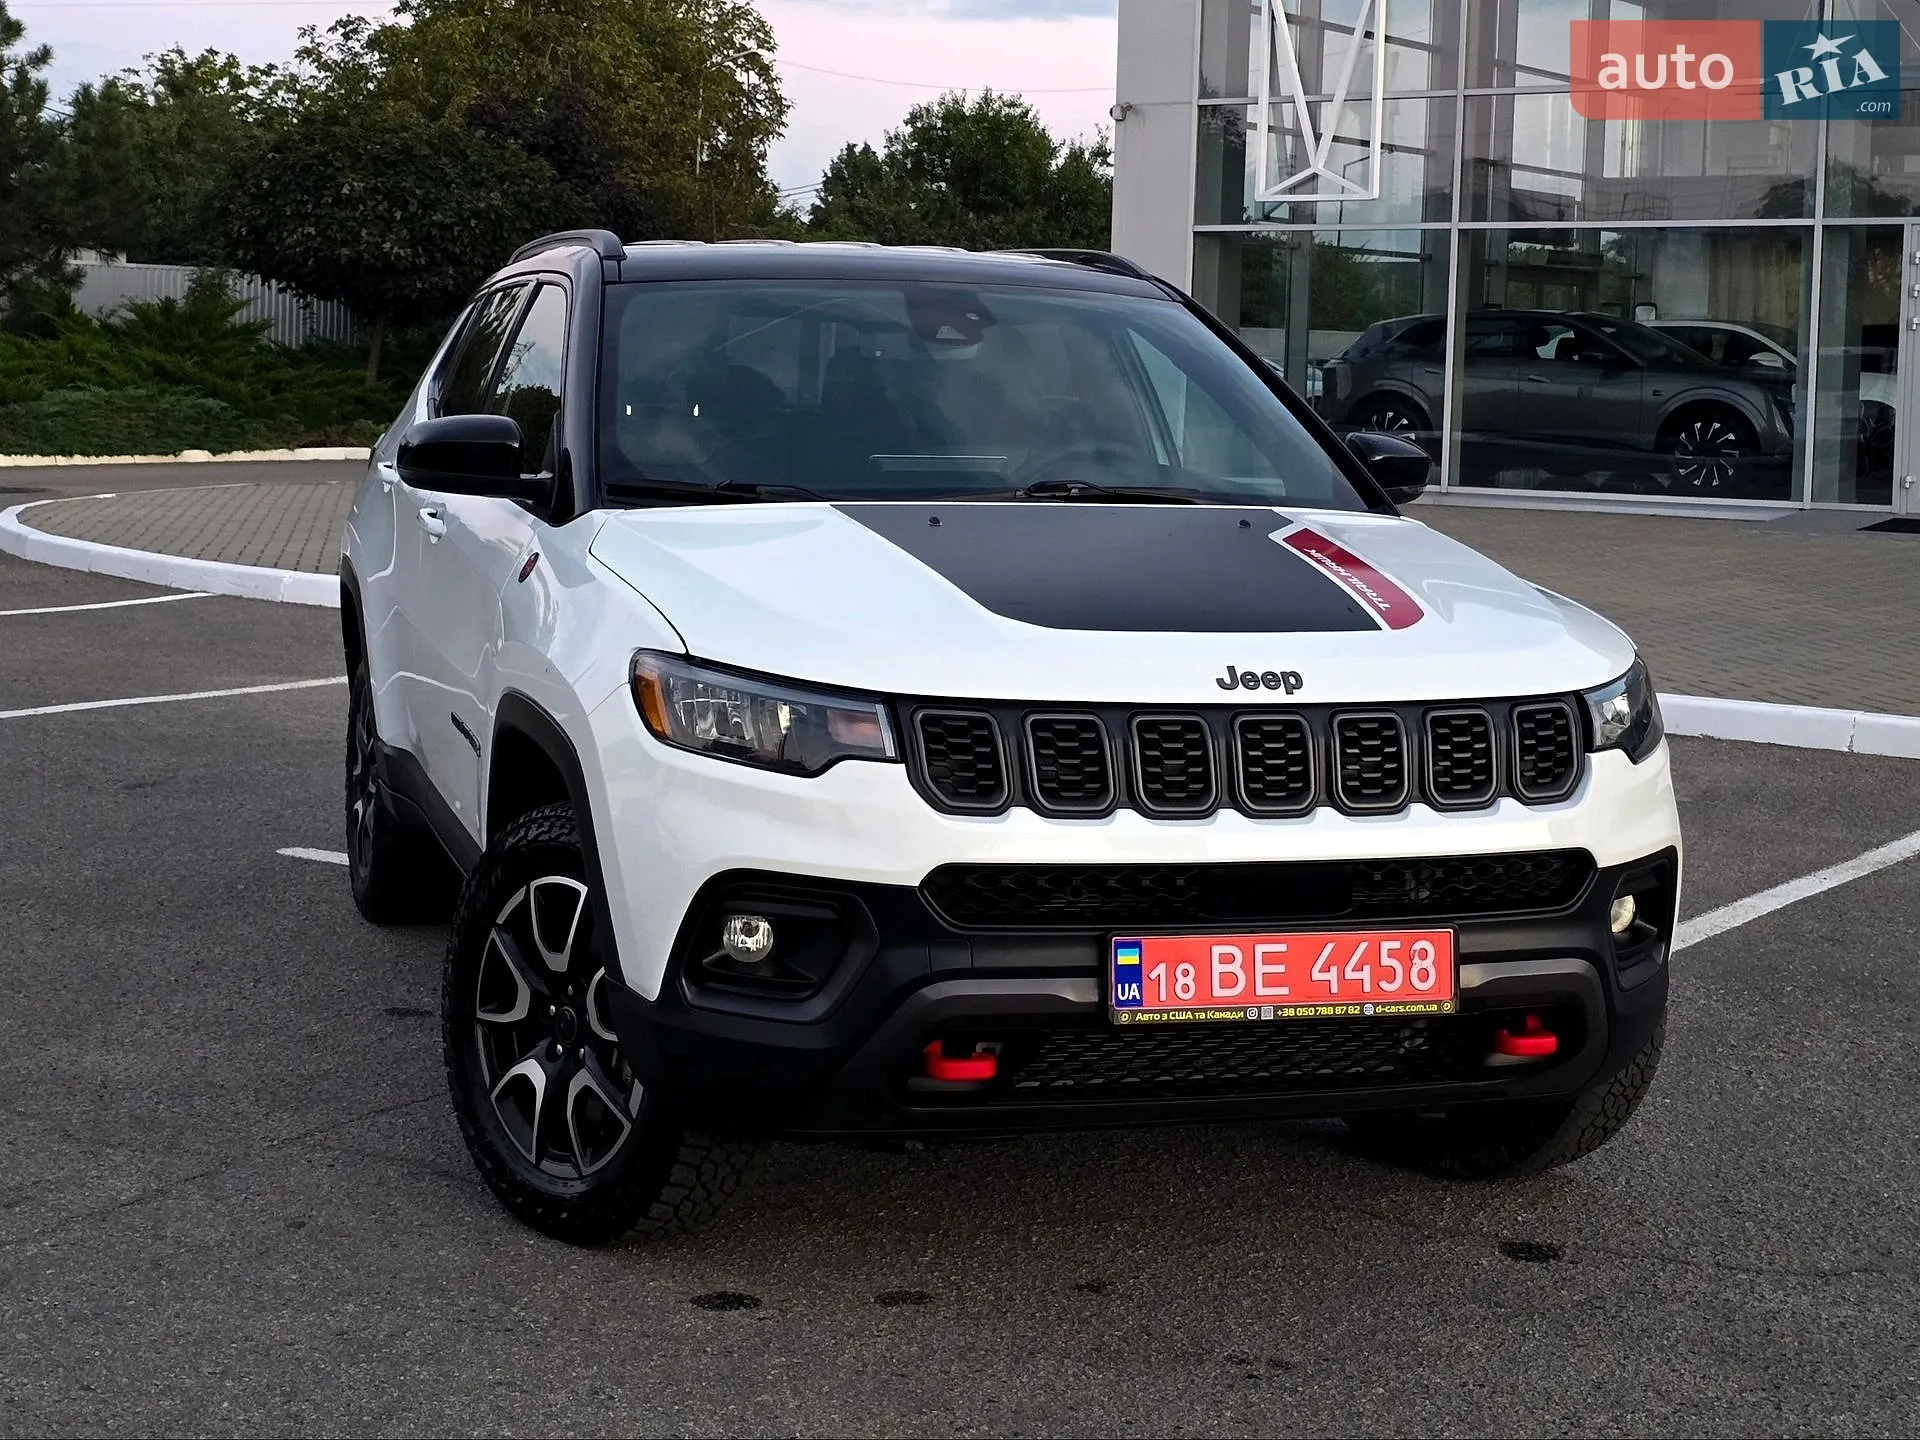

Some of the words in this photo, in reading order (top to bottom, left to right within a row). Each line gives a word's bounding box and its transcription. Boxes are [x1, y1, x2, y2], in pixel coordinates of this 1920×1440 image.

[1216, 665, 1304, 695] Jeep
[1147, 962, 1196, 1002] 18
[1210, 943, 1289, 998] BE
[1311, 939, 1436, 994] 4458
[1117, 983, 1140, 1001] UA
[1135, 1011, 1161, 1021] Авто
[1169, 1011, 1193, 1020] США
[1194, 1012, 1206, 1020] та
[1207, 1009, 1244, 1020] Канади
[1276, 1009, 1295, 1017] +38
[1296, 1007, 1315, 1016] 050
[1316, 1007, 1334, 1016] 788
[1335, 1006, 1347, 1015] 87
[1347, 1006, 1361, 1015] 82
[1375, 1004, 1438, 1013] d-cars.com.ua
